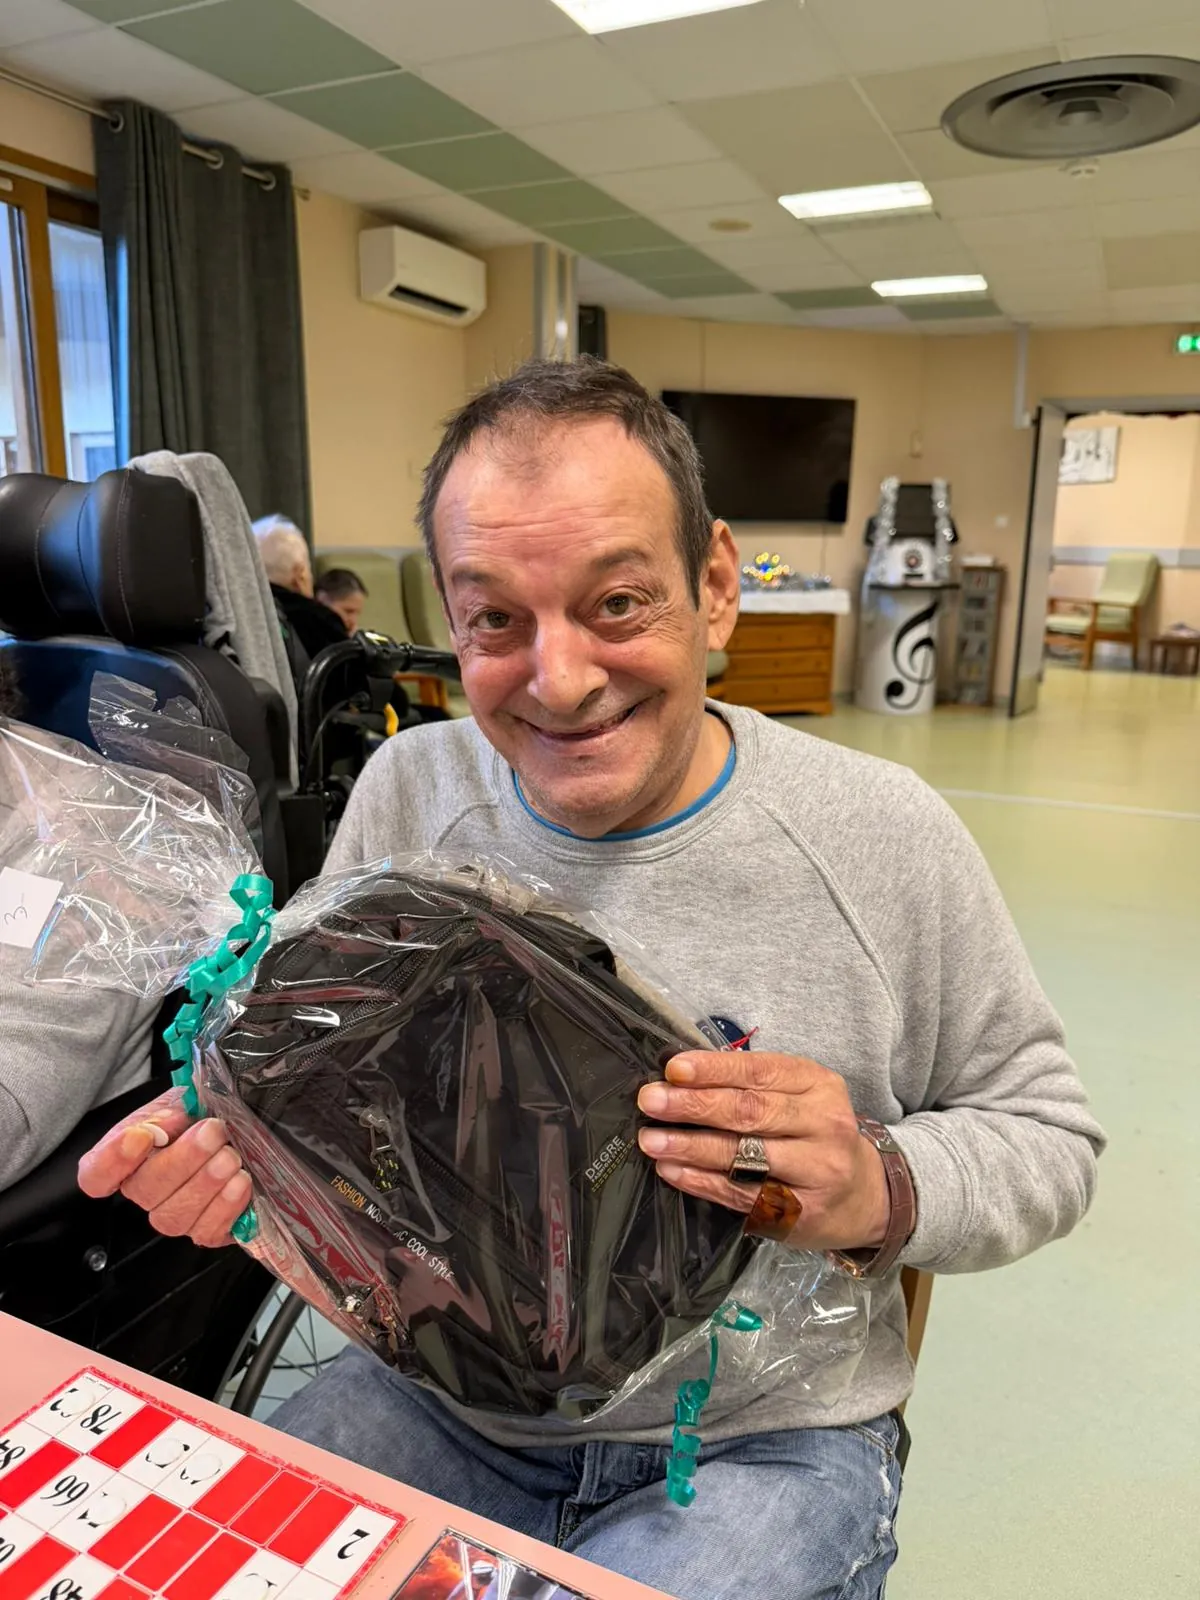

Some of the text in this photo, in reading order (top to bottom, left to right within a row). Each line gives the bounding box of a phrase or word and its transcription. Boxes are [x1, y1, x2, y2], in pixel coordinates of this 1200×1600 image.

[585, 1135, 623, 1180] DEGRE
[330, 1175, 368, 1209] FASHION
[406, 1237, 428, 1261] COOL
[428, 1256, 455, 1281] STYLE
[80, 1404, 122, 1435] 78
[40, 1475, 90, 1507] 66
[337, 1529, 370, 1559] 2
